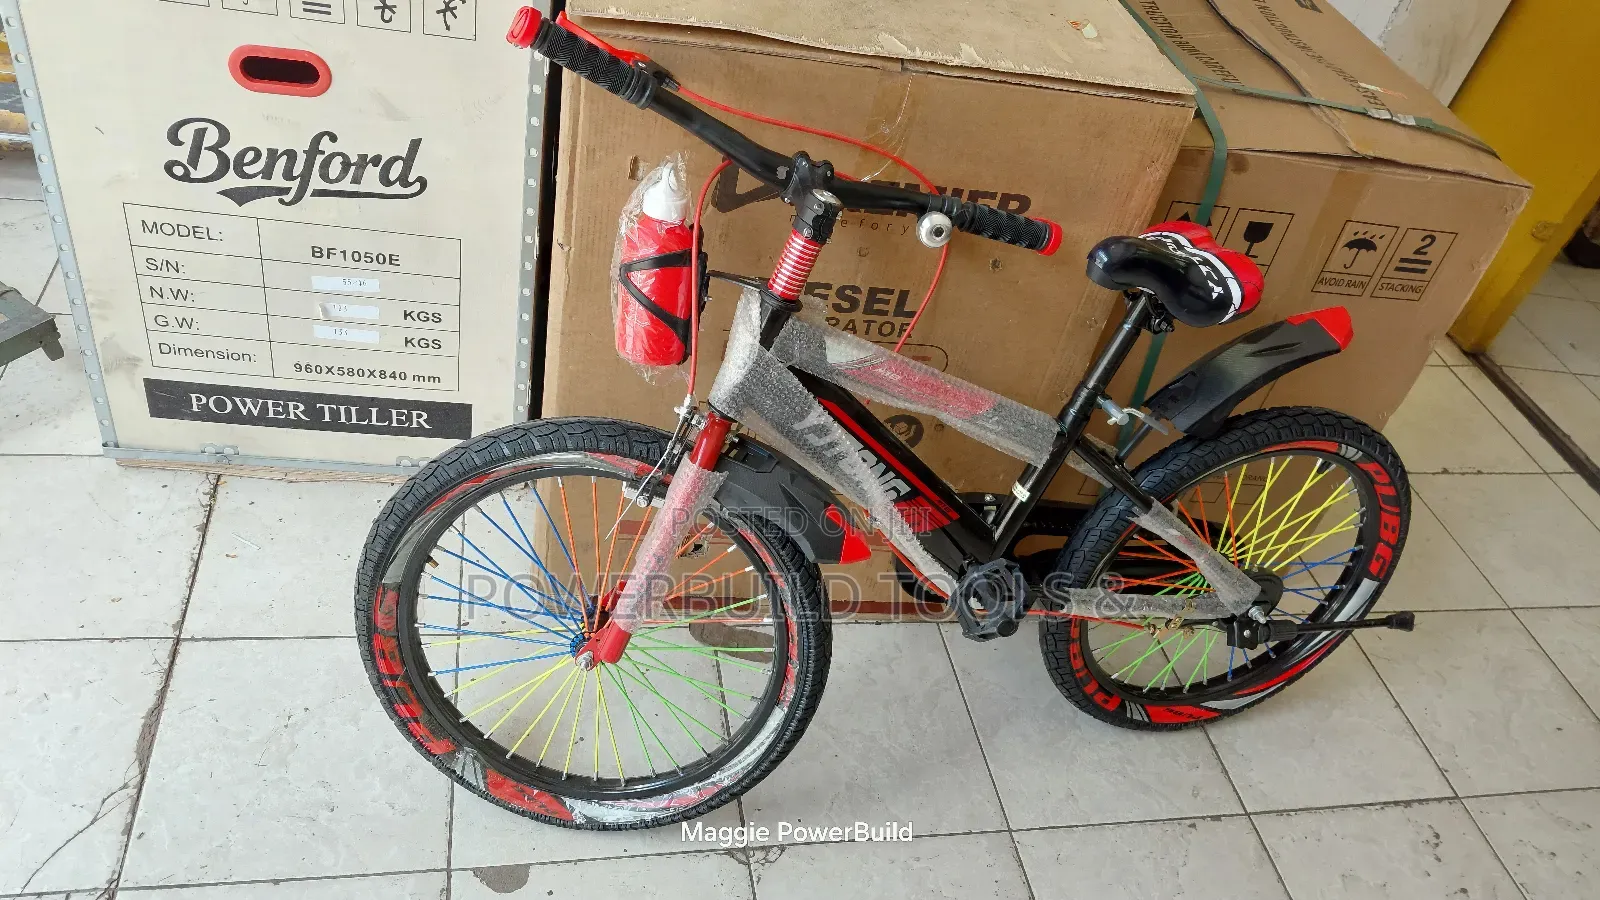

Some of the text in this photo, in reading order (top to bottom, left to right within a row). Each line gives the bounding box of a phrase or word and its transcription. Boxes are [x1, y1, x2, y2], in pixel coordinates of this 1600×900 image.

[163, 117, 428, 207] Benford
[141, 219, 401, 267] MODEL: BF1050E
[1413, 234, 1437, 256] 2
[145, 257, 186, 274] S/N:
[1317, 276, 1367, 290] AVOID RAIN
[150, 285, 195, 302] N.W:
[403, 309, 443, 324] KGS
[1378, 282, 1424, 294] STACKING
[154, 314, 200, 331] G.W:
[403, 336, 443, 350] KGS
[158, 342, 441, 384] Dimension: 960X580X840 mm
[189, 392, 433, 429] POWER TILLER
[1353, 461, 1401, 579] PUBG
